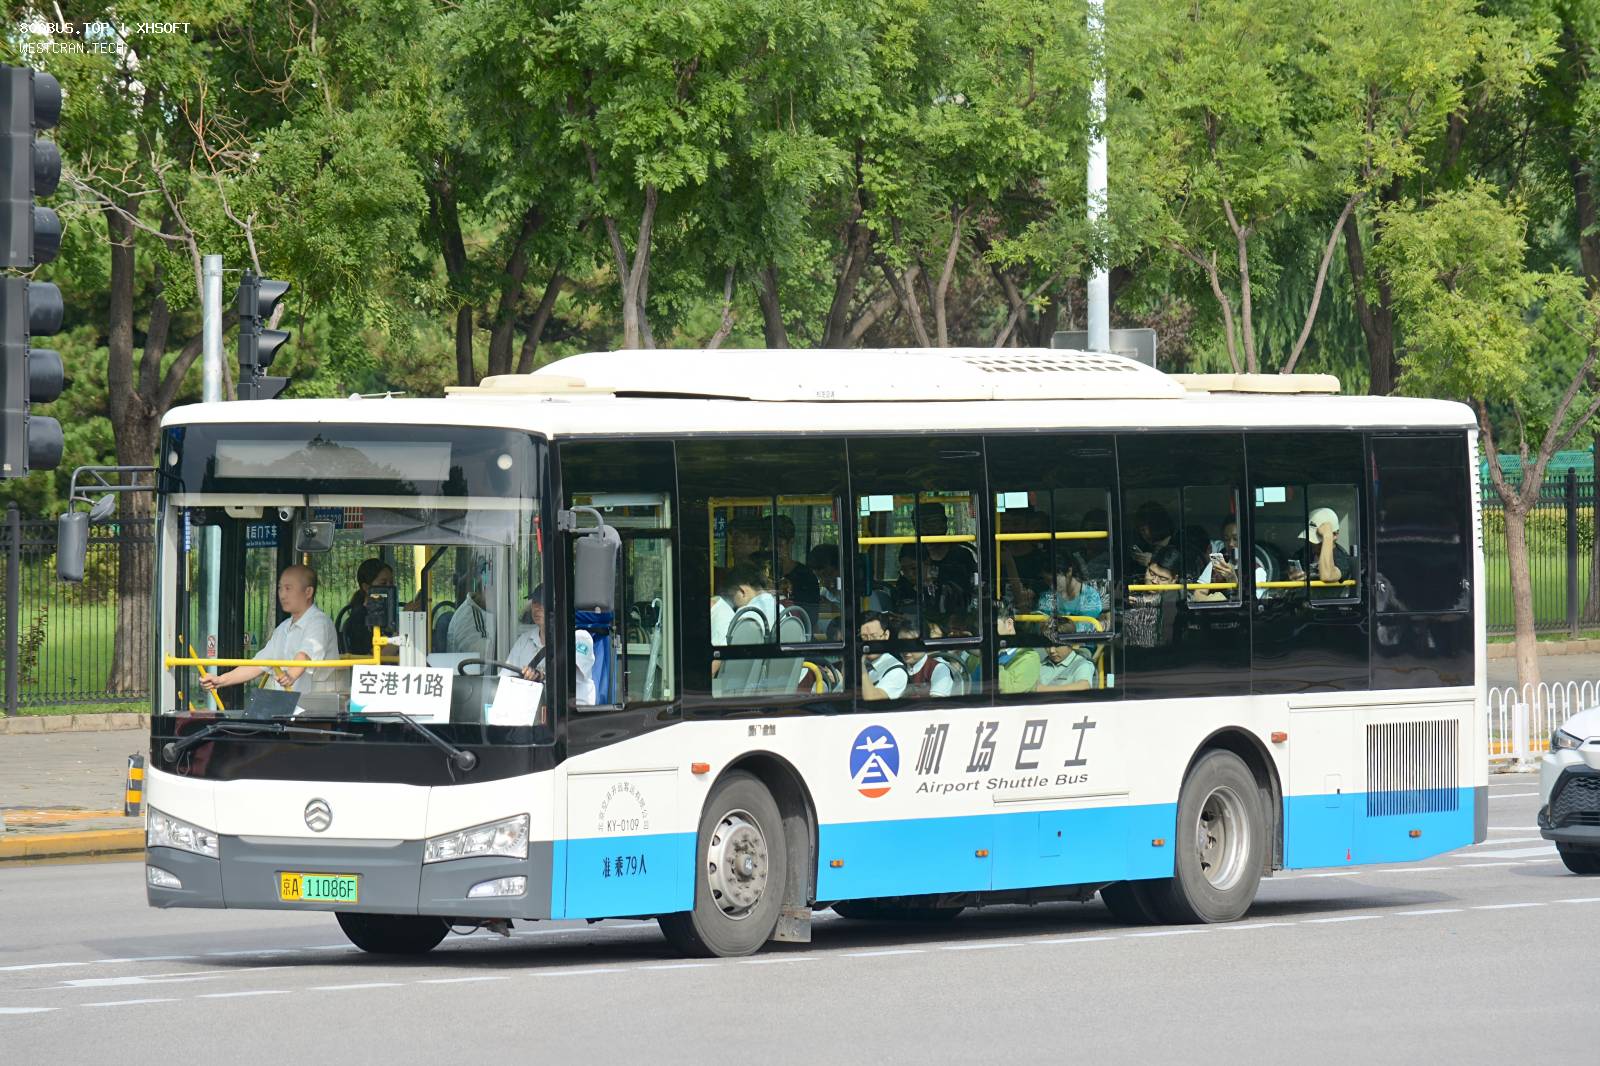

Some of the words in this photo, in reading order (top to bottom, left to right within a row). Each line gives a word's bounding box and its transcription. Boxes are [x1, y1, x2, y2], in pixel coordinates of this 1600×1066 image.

[358, 671, 444, 698] 空港11路
[915, 715, 1097, 776] 机场巴士
[915, 780, 980, 795] Airport
[986, 775, 1049, 791] Shuttle
[1055, 773, 1088, 786] Bus
[607, 818, 640, 832] KY-0109
